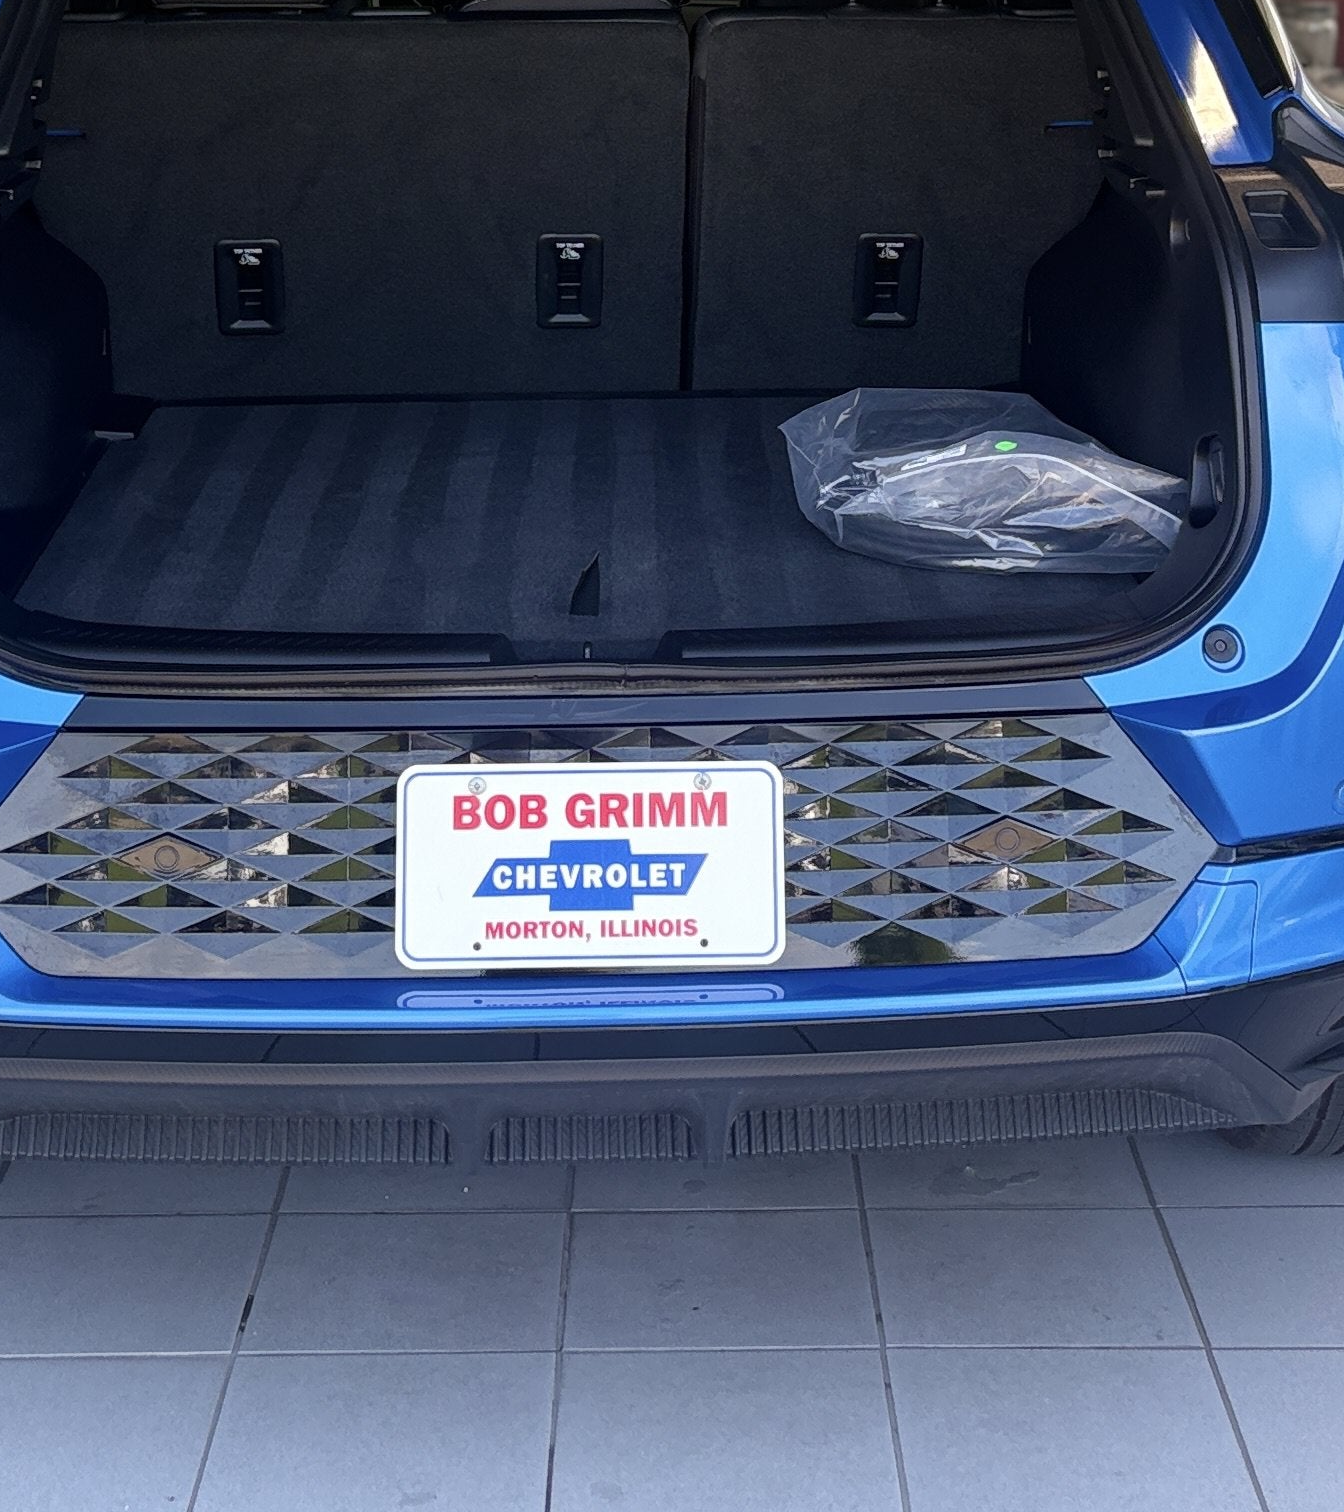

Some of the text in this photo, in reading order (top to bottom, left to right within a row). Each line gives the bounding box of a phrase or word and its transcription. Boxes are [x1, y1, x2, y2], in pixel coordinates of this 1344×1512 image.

[452, 791, 728, 831] BOB GRIMM
[492, 863, 686, 890] CHEVROLET
[484, 918, 699, 943] MORTON, ILLINOIS
